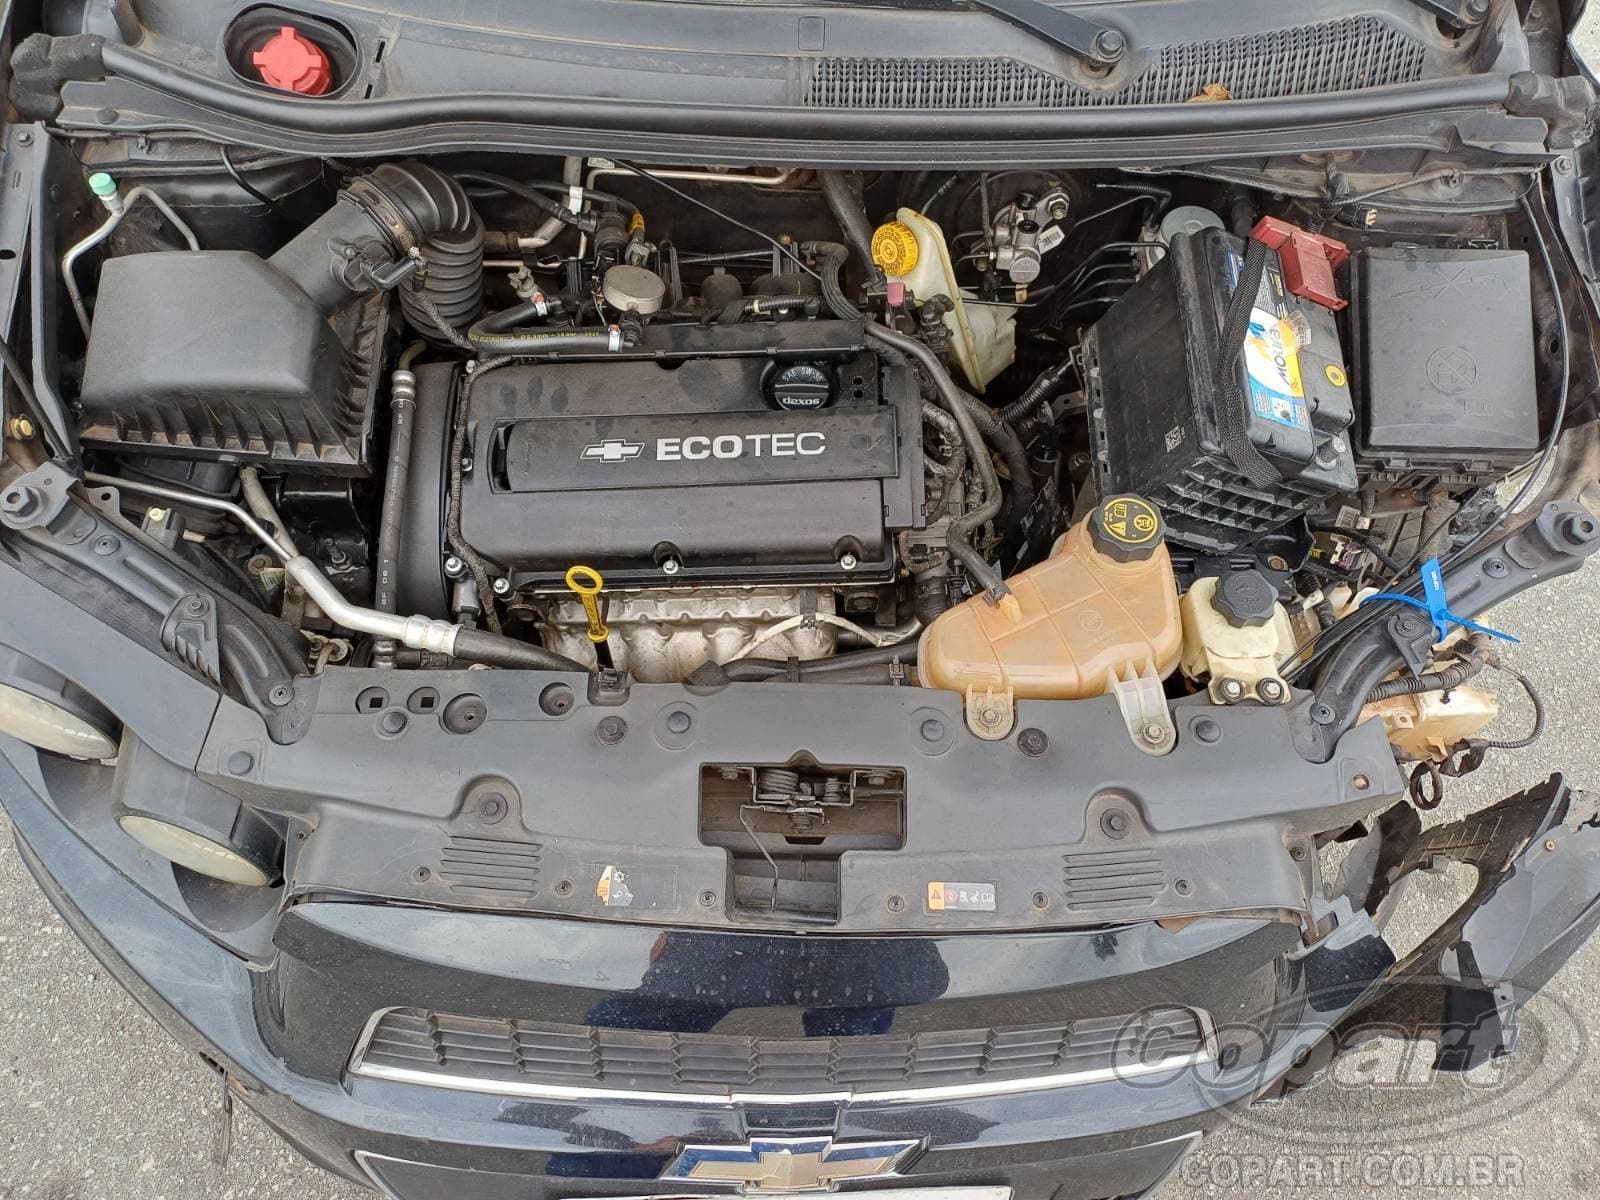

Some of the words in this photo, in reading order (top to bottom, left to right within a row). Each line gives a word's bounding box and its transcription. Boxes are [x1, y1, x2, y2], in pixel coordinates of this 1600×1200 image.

[782, 368, 798, 382] SAE
[782, 396, 820, 406] dexos
[656, 431, 826, 461] ECOTEC
